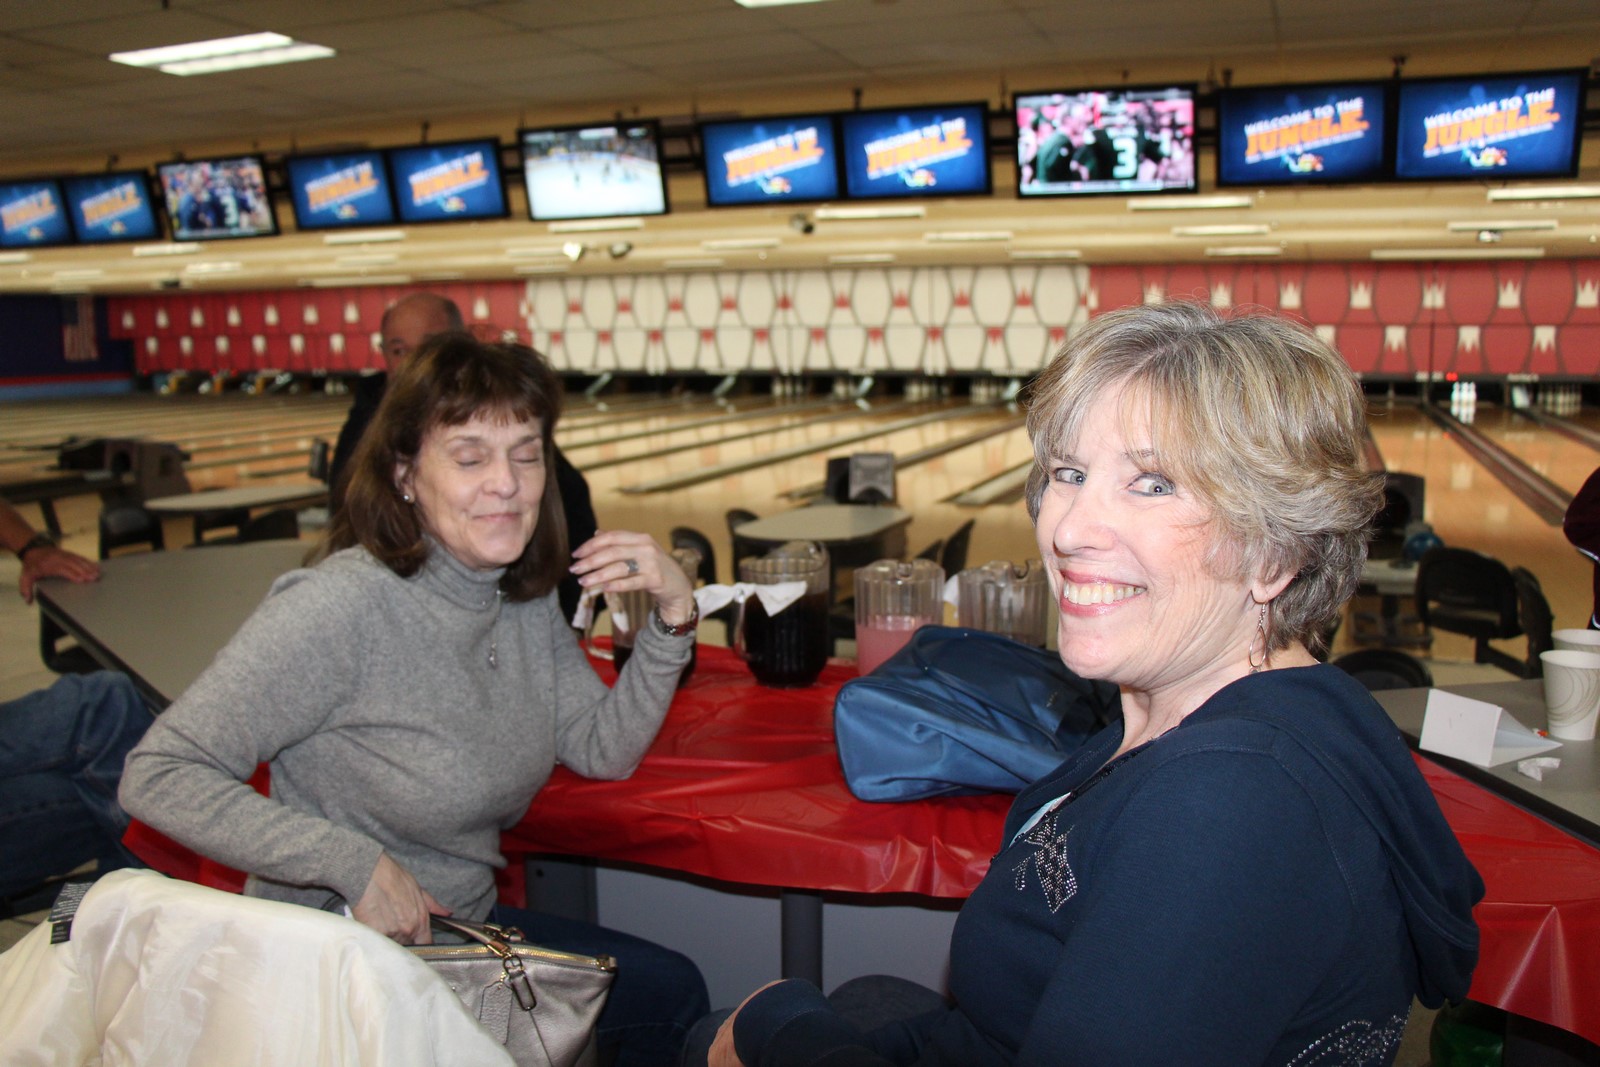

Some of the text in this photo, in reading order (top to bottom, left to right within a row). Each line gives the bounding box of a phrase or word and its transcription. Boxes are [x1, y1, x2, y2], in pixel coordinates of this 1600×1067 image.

[1313, 104, 1335, 118] TO
[1336, 97, 1363, 114] THE
[1424, 87, 1555, 128] WELCOME TO THE
[1112, 137, 1138, 179] 3
